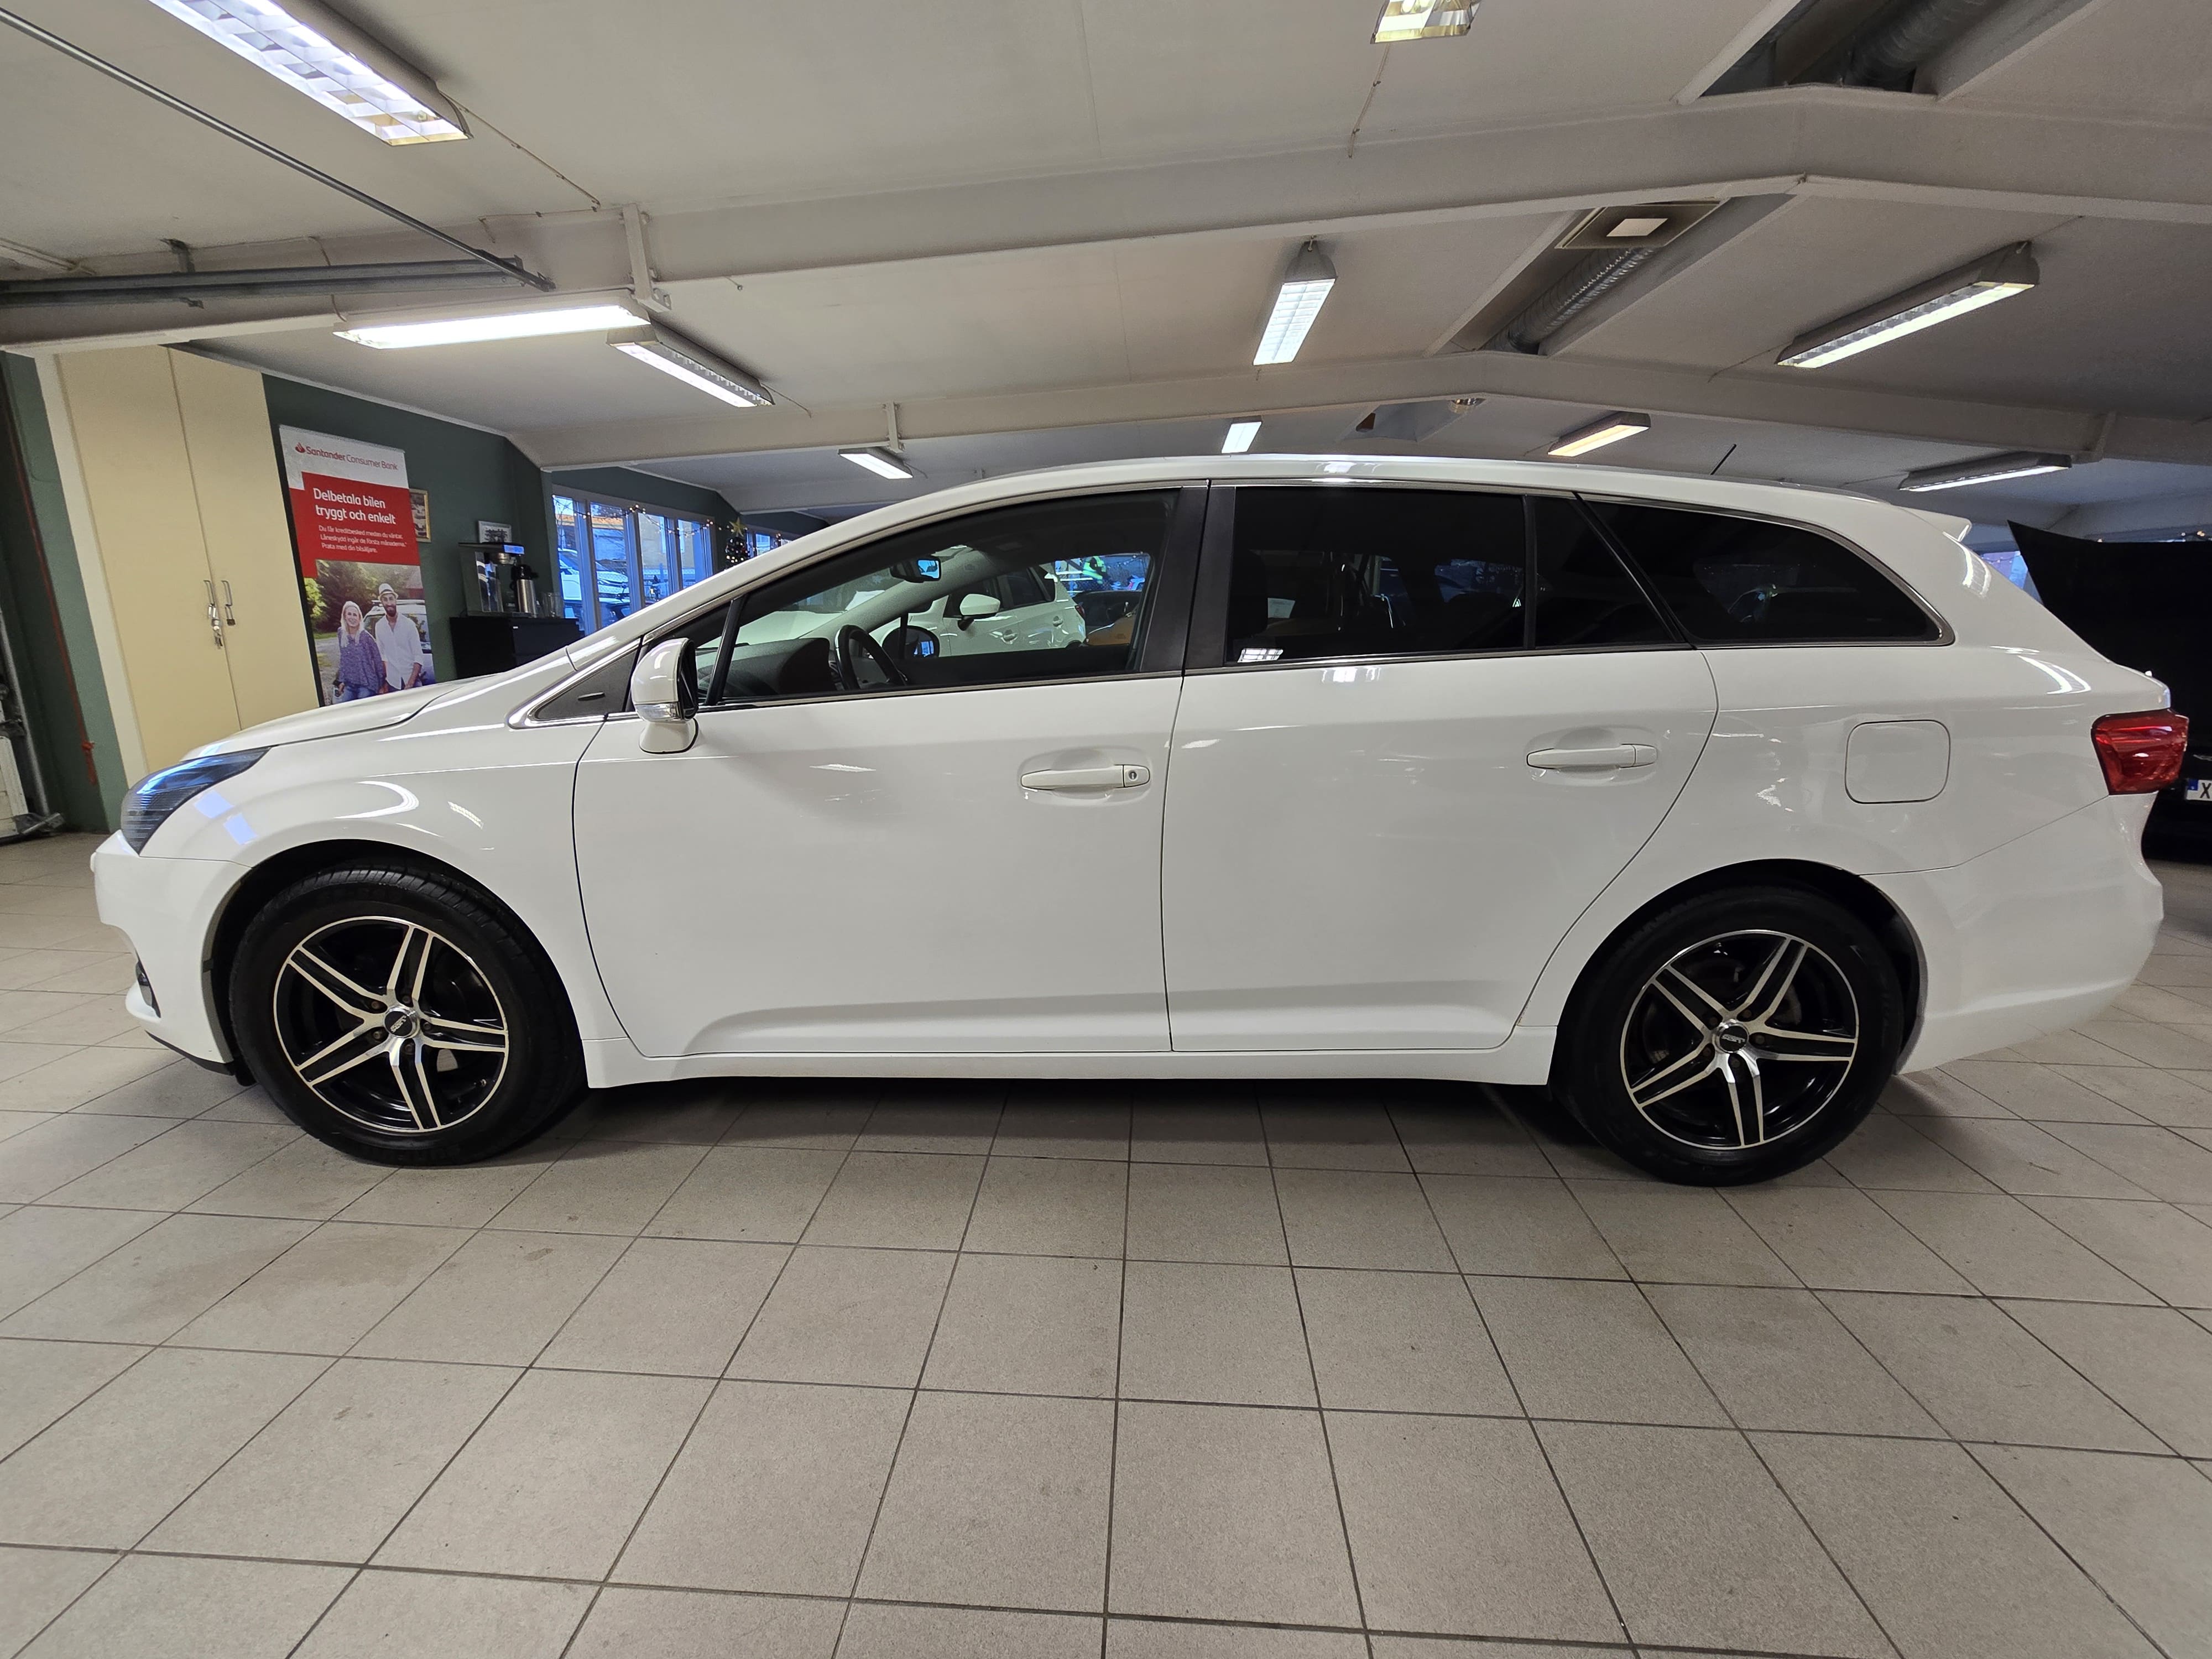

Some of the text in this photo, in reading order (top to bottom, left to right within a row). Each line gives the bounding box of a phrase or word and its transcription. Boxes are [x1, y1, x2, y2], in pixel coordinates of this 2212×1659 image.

[306, 446, 399, 470] Santander Consumer Bank
[313, 488, 386, 509] Delbetala bilen
[315, 504, 397, 525] tryggt och enkelt
[2200, 782, 2212, 799] X
